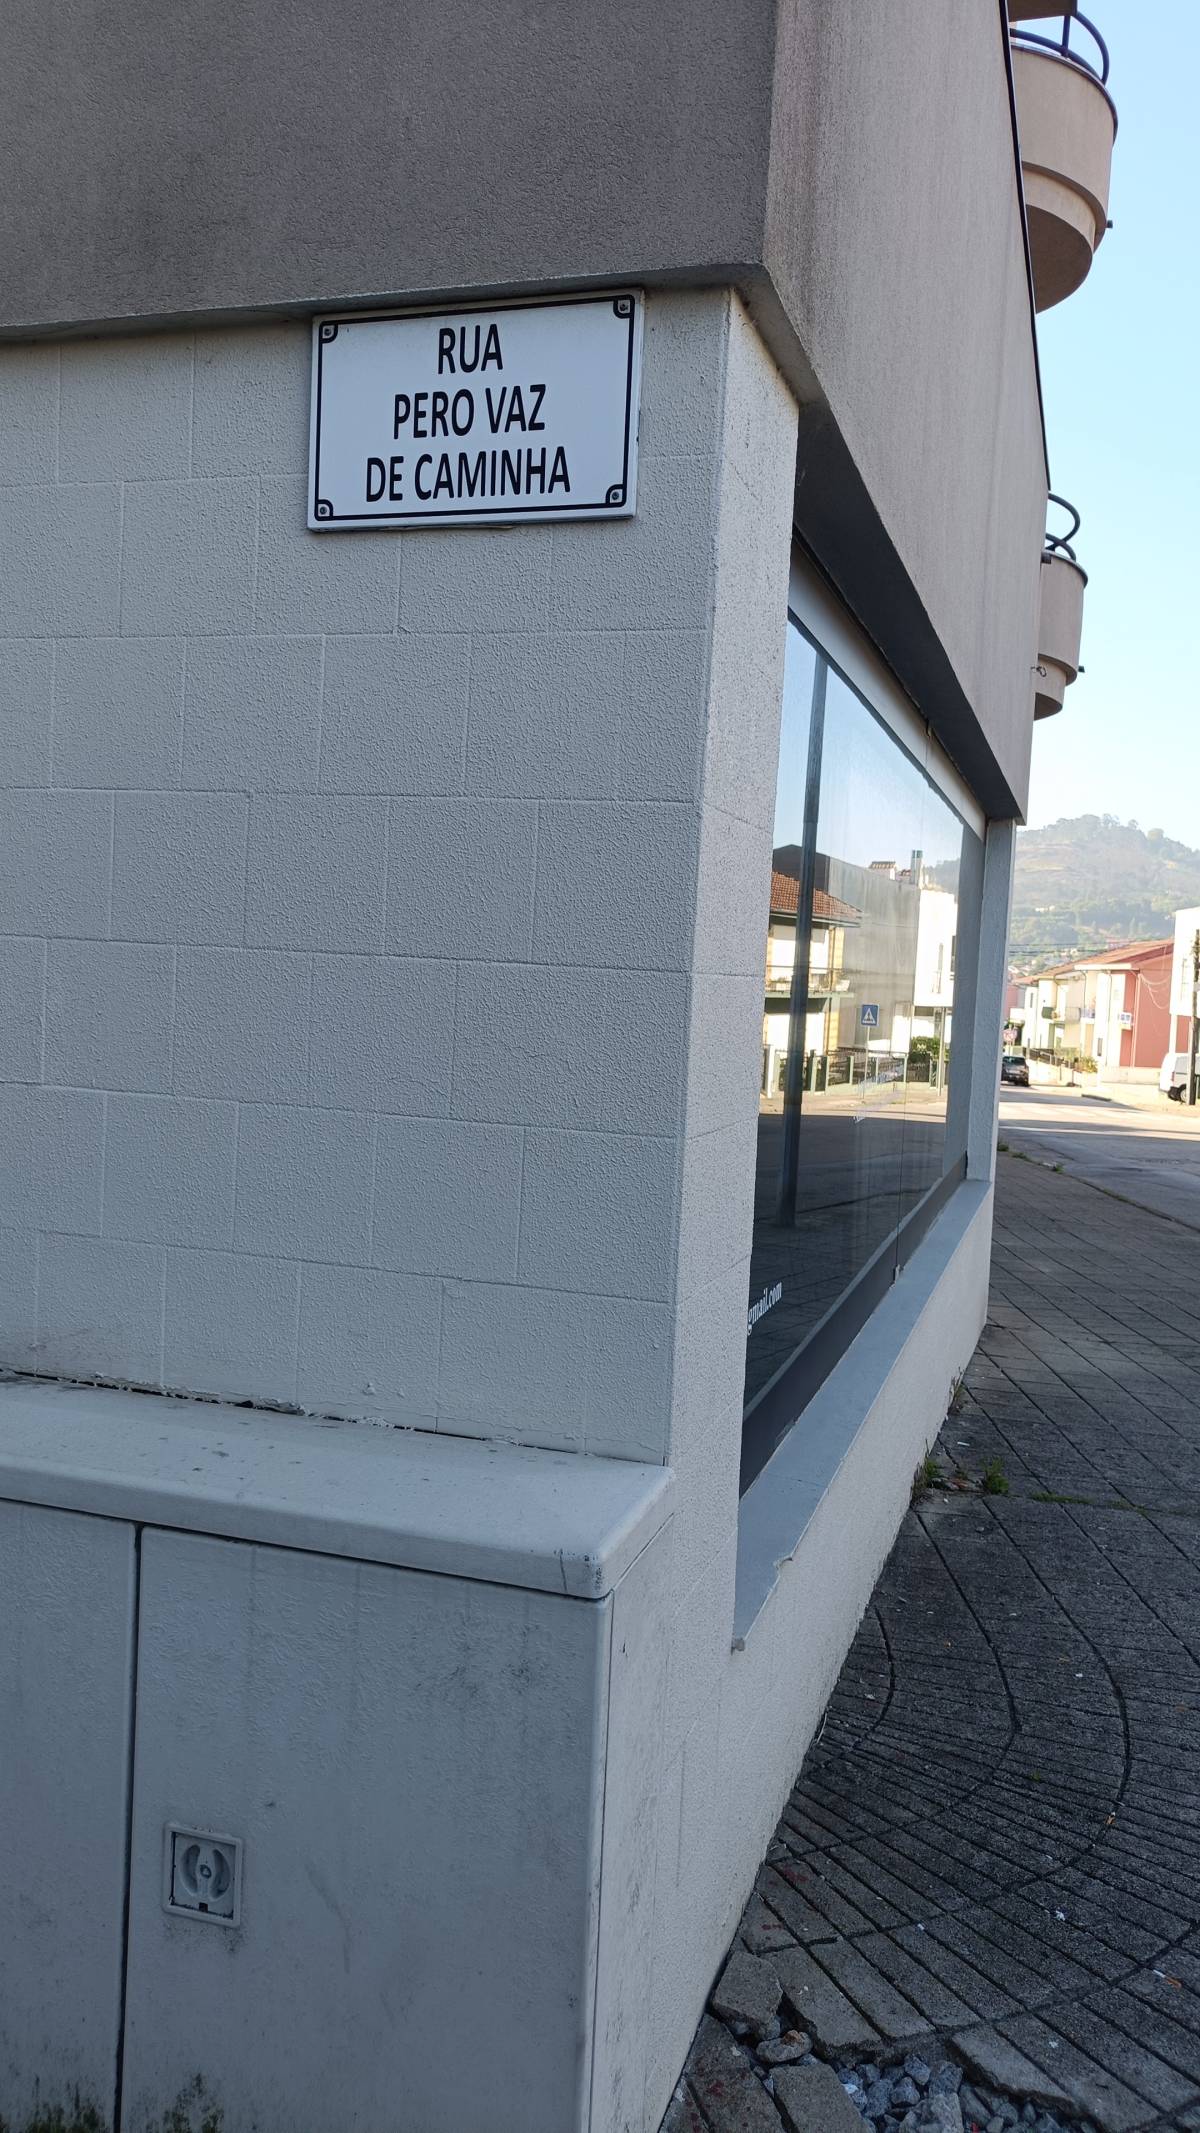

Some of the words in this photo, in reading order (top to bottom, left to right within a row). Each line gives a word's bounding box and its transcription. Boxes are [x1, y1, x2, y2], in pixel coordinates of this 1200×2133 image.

[437, 323, 504, 375] RUA
[393, 388, 475, 440] PERO
[484, 383, 547, 434] VAZ
[366, 455, 405, 503] DE
[414, 445, 571, 501] CAMINHA
